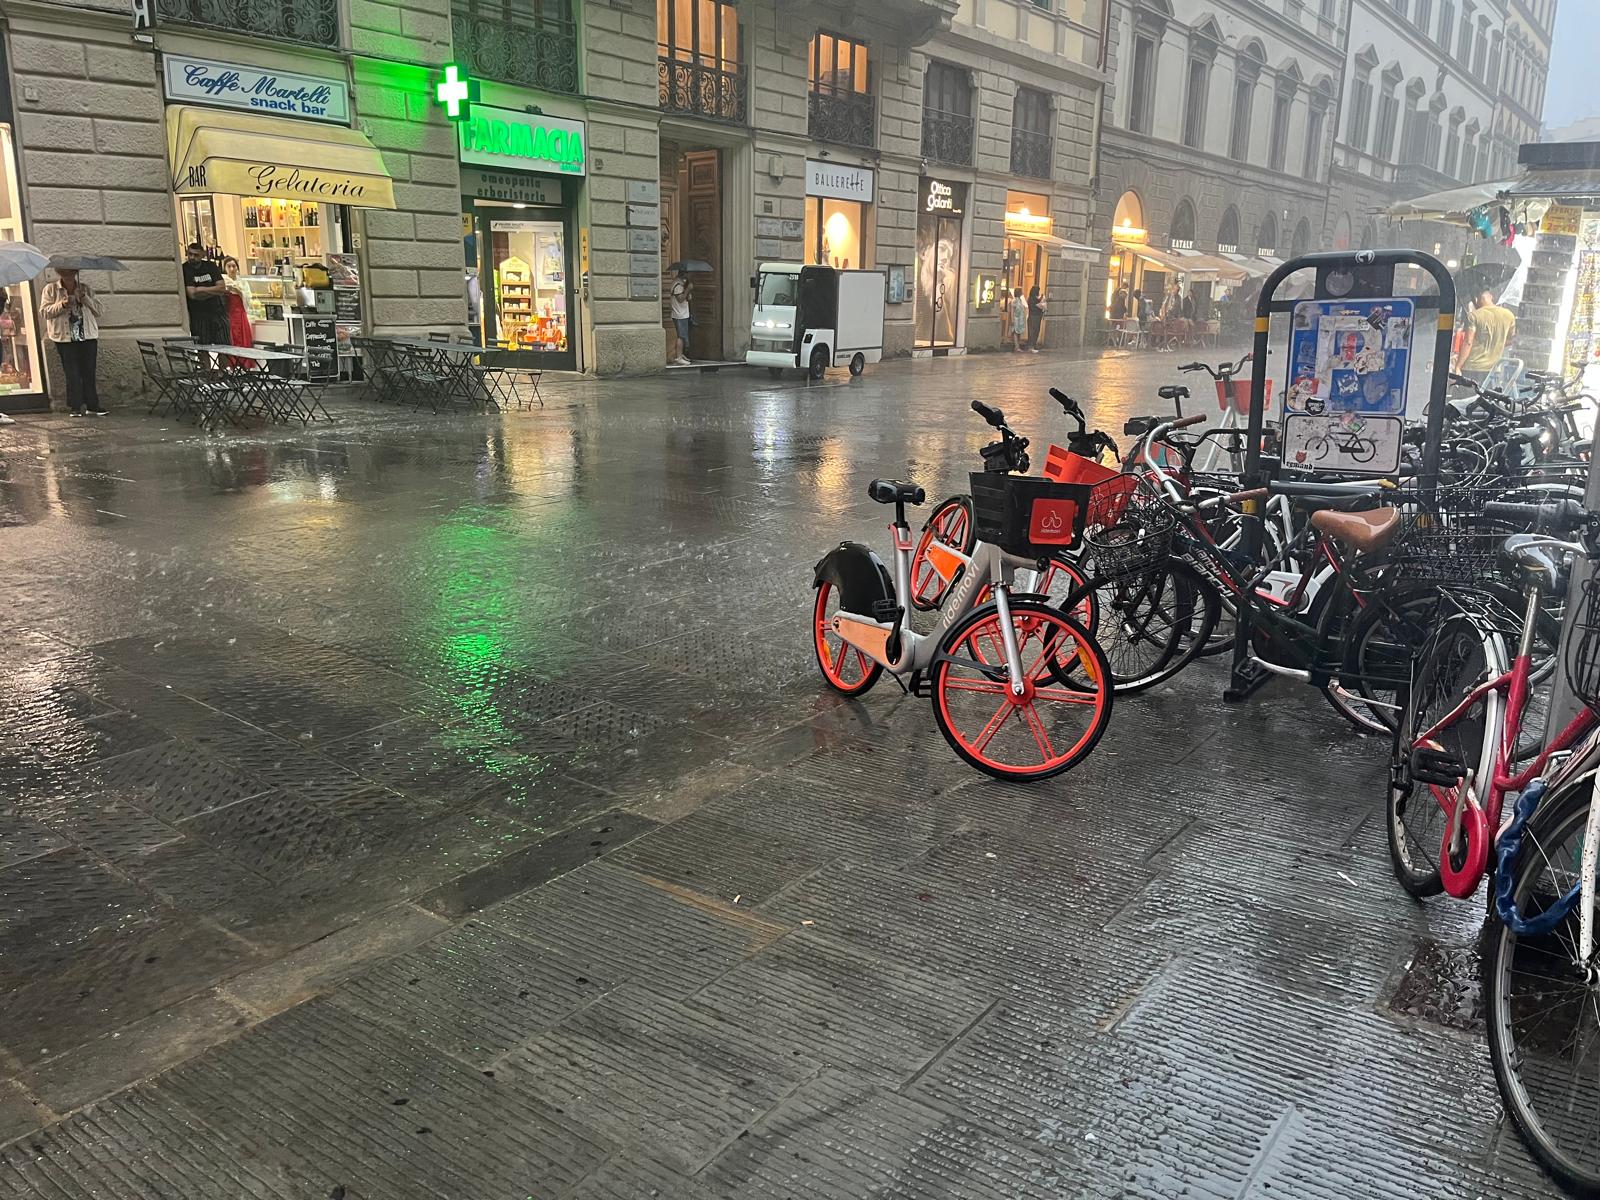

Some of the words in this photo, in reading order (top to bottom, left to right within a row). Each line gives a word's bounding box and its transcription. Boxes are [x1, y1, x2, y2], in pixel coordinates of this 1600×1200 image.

[184, 64, 241, 95] Caffè
[242, 75, 331, 104] Martelli
[250, 96, 297, 112] snack
[301, 101, 326, 116] bar
[463, 118, 584, 163] FARMACIA
[188, 165, 206, 187] BAR
[248, 165, 367, 197] Gelateria
[481, 173, 541, 188] omeopatia
[477, 186, 546, 202] erboristeria
[931, 181, 952, 196] Ottica
[1172, 239, 1193, 249] EATALY
[1218, 244, 1237, 253] EATALY
[942, 560, 980, 629] ridemovi
